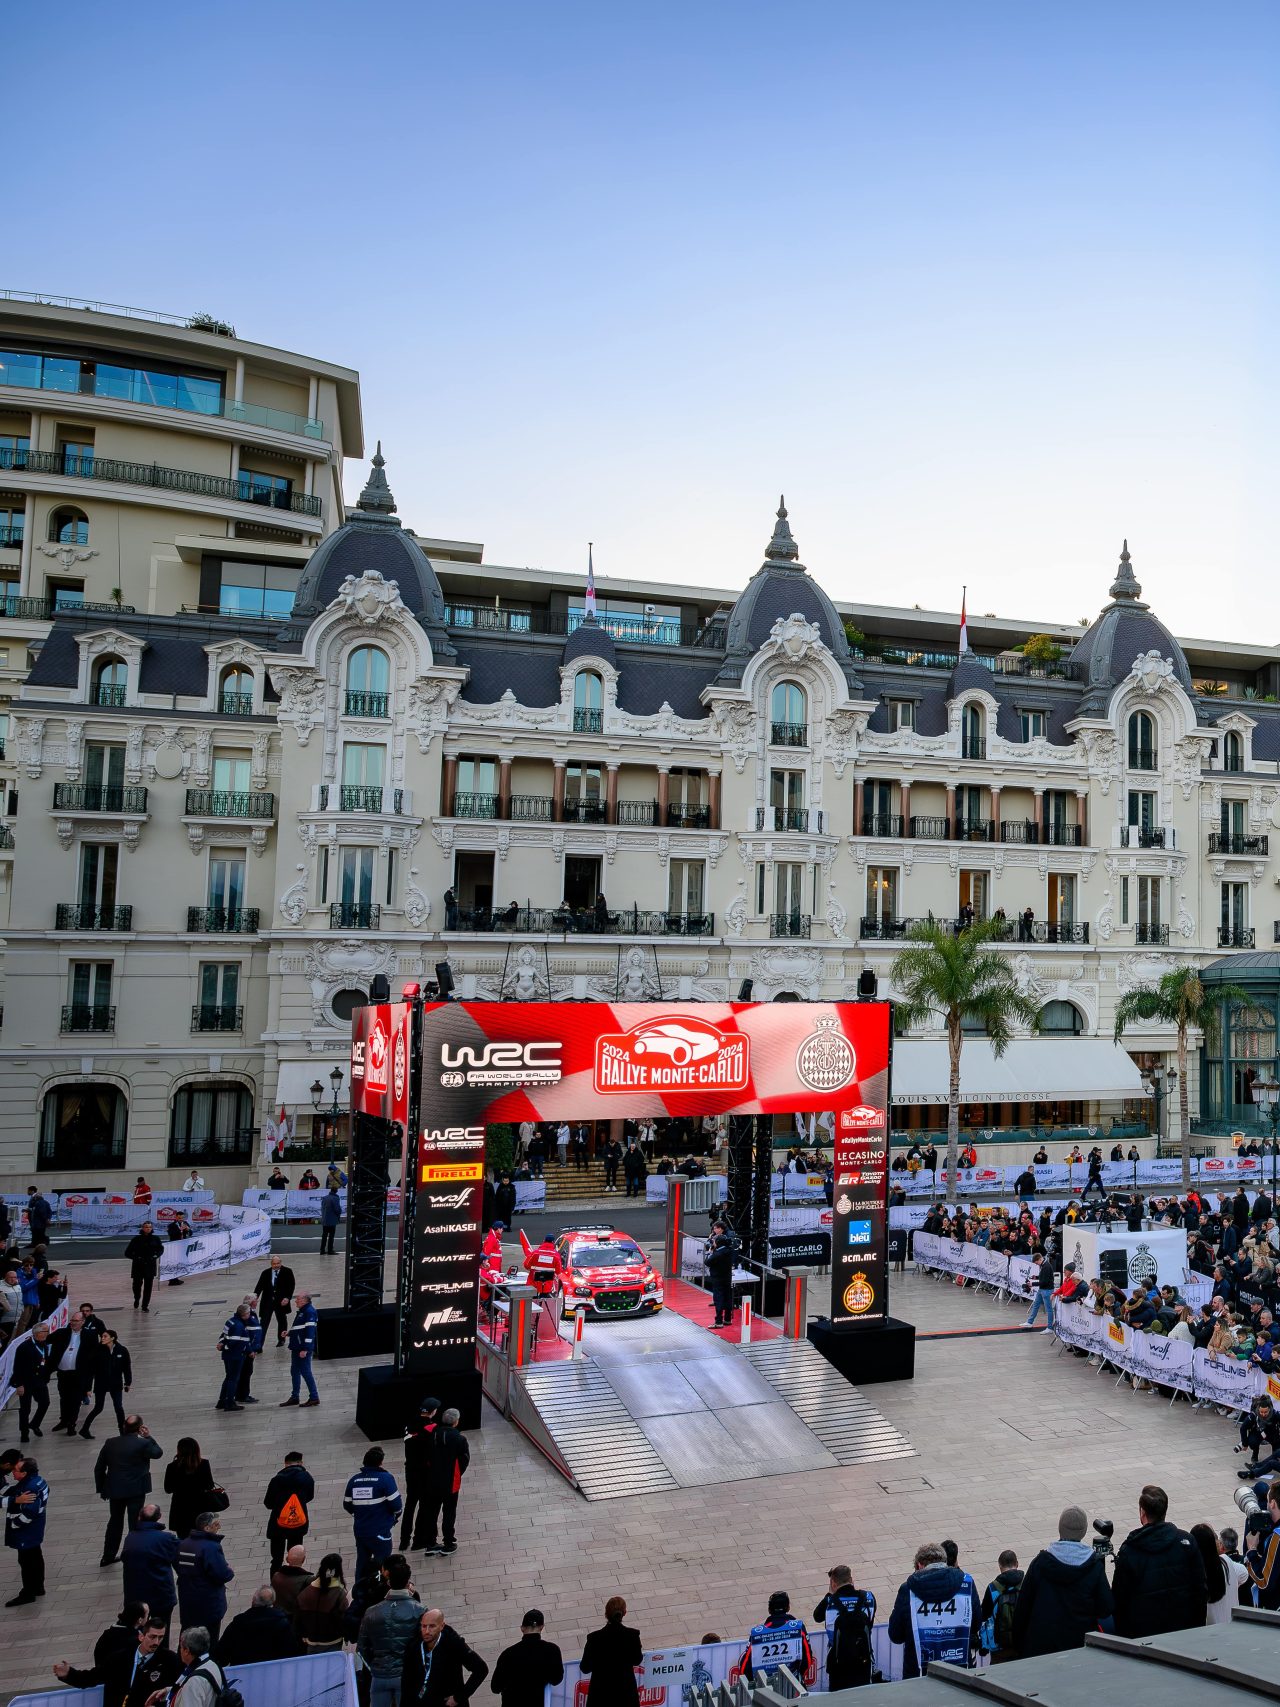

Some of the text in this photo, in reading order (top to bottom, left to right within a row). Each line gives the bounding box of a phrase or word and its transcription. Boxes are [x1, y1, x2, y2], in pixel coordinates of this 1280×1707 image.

[442, 1043, 562, 1067] WRC
[602, 1042, 630, 1062] 2024
[717, 1042, 744, 1061] 2024
[601, 1053, 743, 1086] RALLYE MONTE-CARLO
[441, 1072, 465, 1087] FIA
[424, 1127, 484, 1141] WRC
[837, 1150, 885, 1161] LE CASINO
[429, 1167, 477, 1178] PIRELLI
[838, 1177, 859, 1185] GR
[424, 1223, 477, 1234] AsahiKASEI
[850, 1233, 870, 1243] bleu
[421, 1254, 475, 1263] FANATEC
[842, 1252, 877, 1263] acm.mc
[421, 1282, 474, 1292] FORUM8
[427, 1337, 475, 1347] CASTORE
[1203, 1357, 1248, 1378] FORUM8
[917, 1598, 957, 1617] 444
[761, 1643, 789, 1658] 222
[940, 1647, 964, 1657] WRC
[652, 1664, 685, 1675] MEDIA
